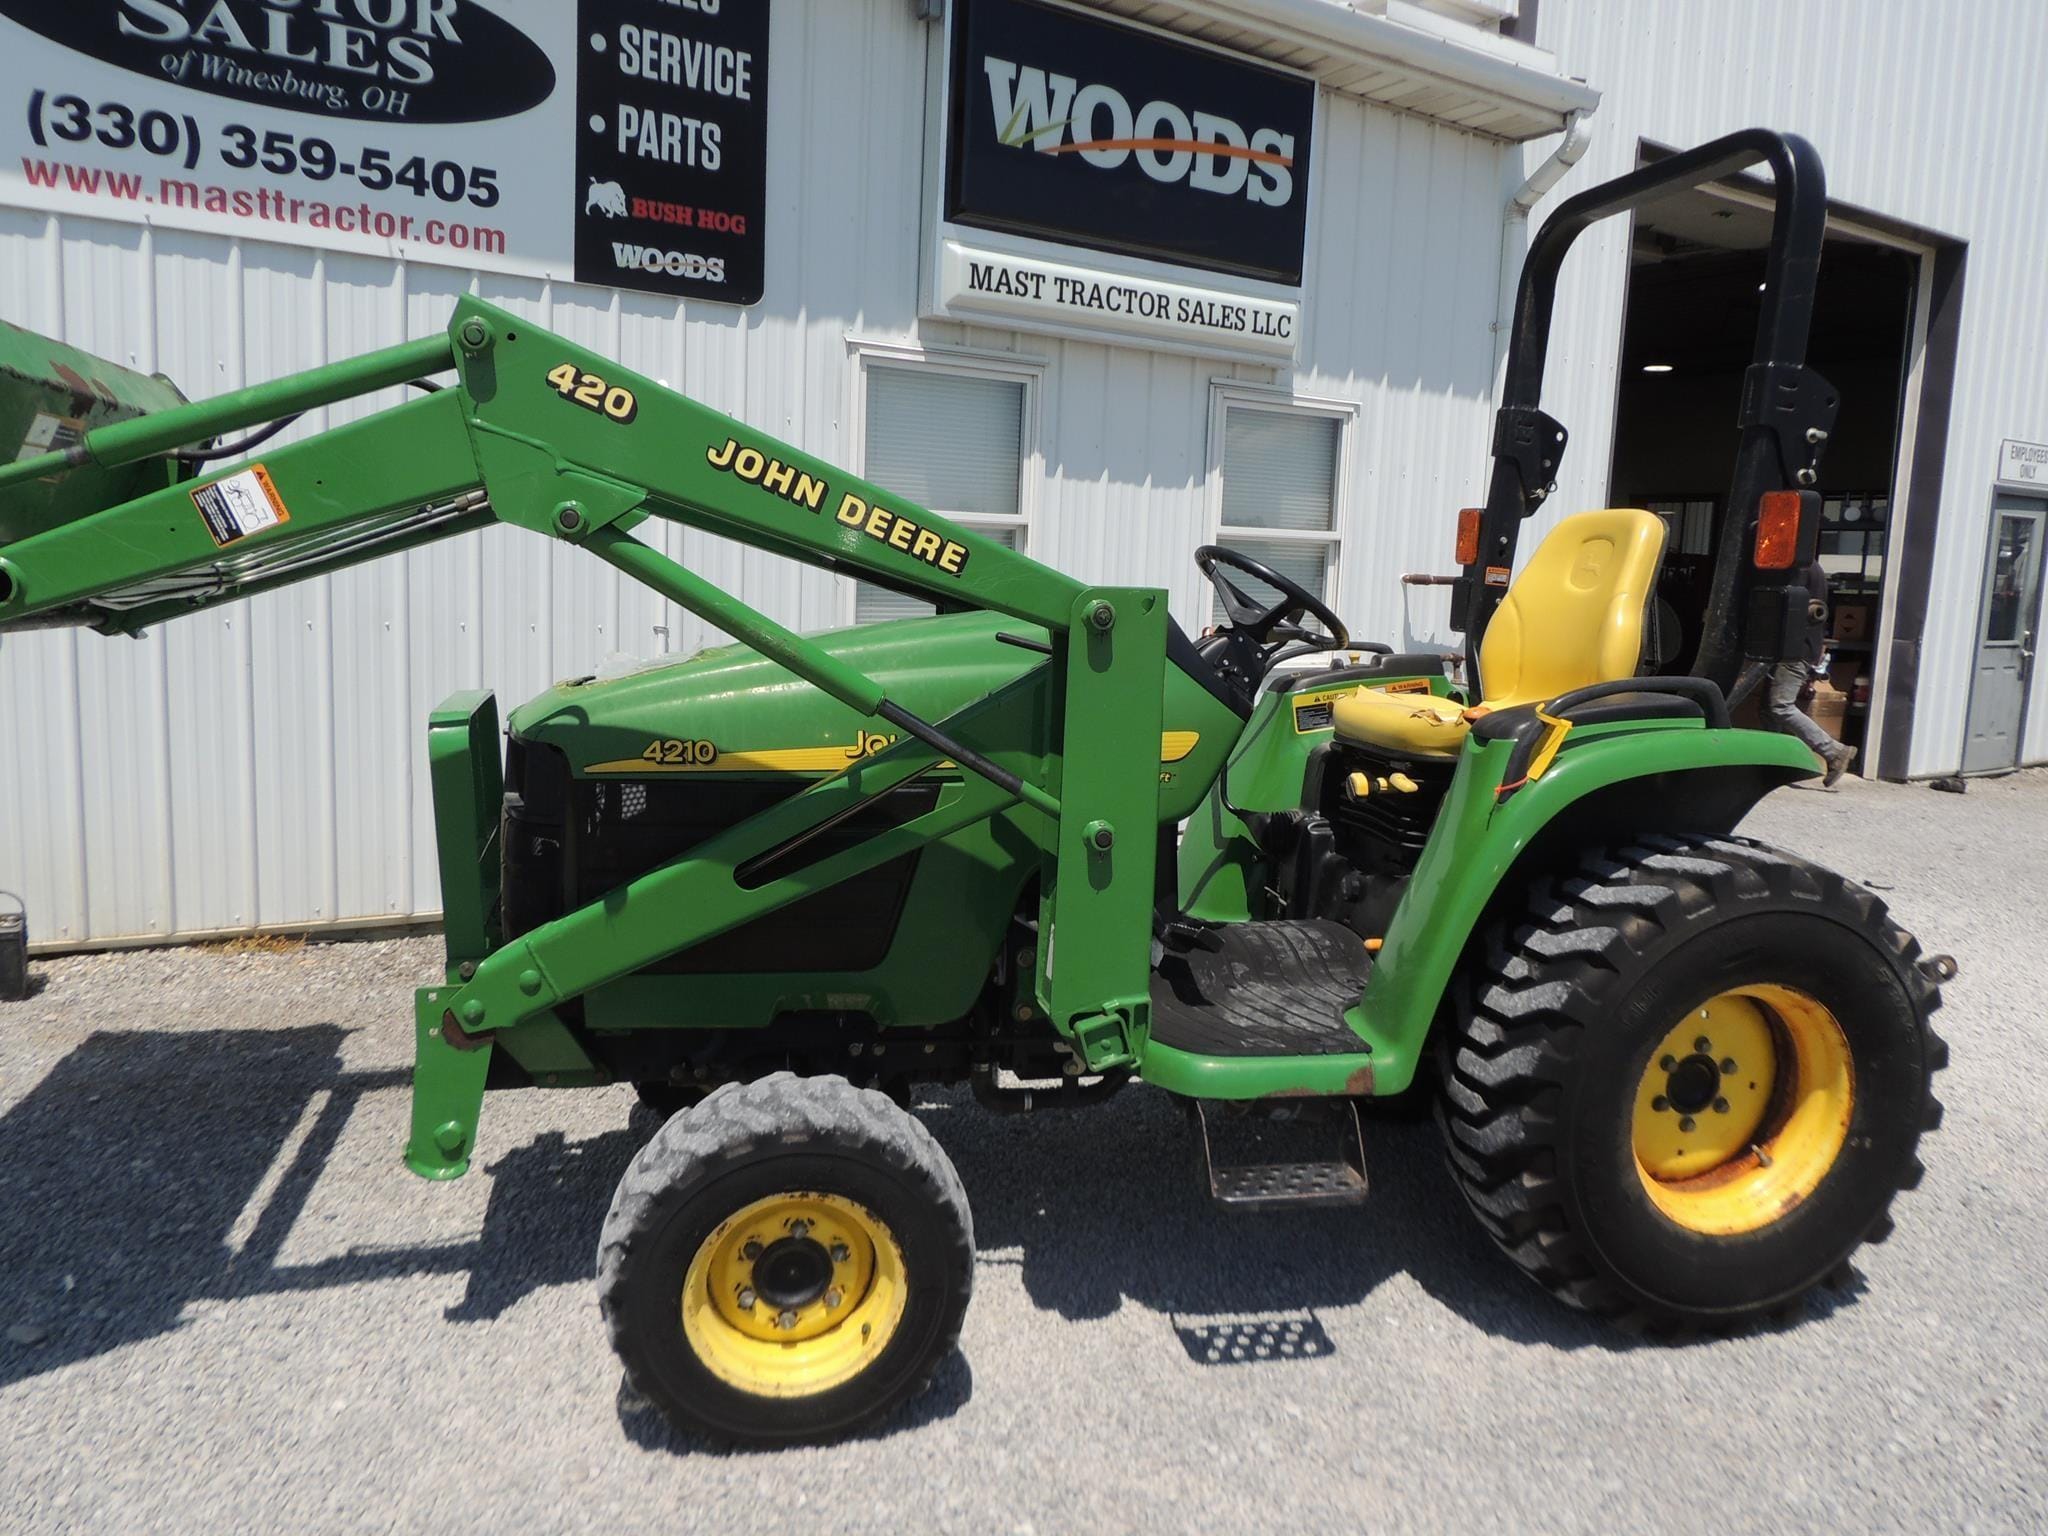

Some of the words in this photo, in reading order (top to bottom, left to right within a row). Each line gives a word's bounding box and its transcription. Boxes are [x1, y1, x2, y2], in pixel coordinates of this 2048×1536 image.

[117, 0, 435, 85] SALES
[619, 23, 752, 101] SERVICE
[160, 49, 197, 81] of
[201, 52, 349, 109] Winesburg,
[362, 86, 411, 117] OH
[27, 88, 201, 170] (330)
[220, 123, 501, 208] 359-5405
[618, 103, 722, 171] PARTS
[984, 55, 1295, 207] WOODS
[21, 156, 506, 255] www.masttractor.com
[631, 197, 693, 227] BUSH
[697, 208, 746, 235] HOG
[611, 241, 725, 283] WOODS
[968, 262, 1046, 300] MAST
[1053, 276, 1171, 320] TRACTOR
[1176, 297, 1247, 332] SALES
[1251, 310, 1292, 339] LLC
[546, 362, 637, 424] 420
[706, 437, 829, 514] JOHN
[835, 491, 970, 578] DEERE
[642, 739, 718, 765] 4210
